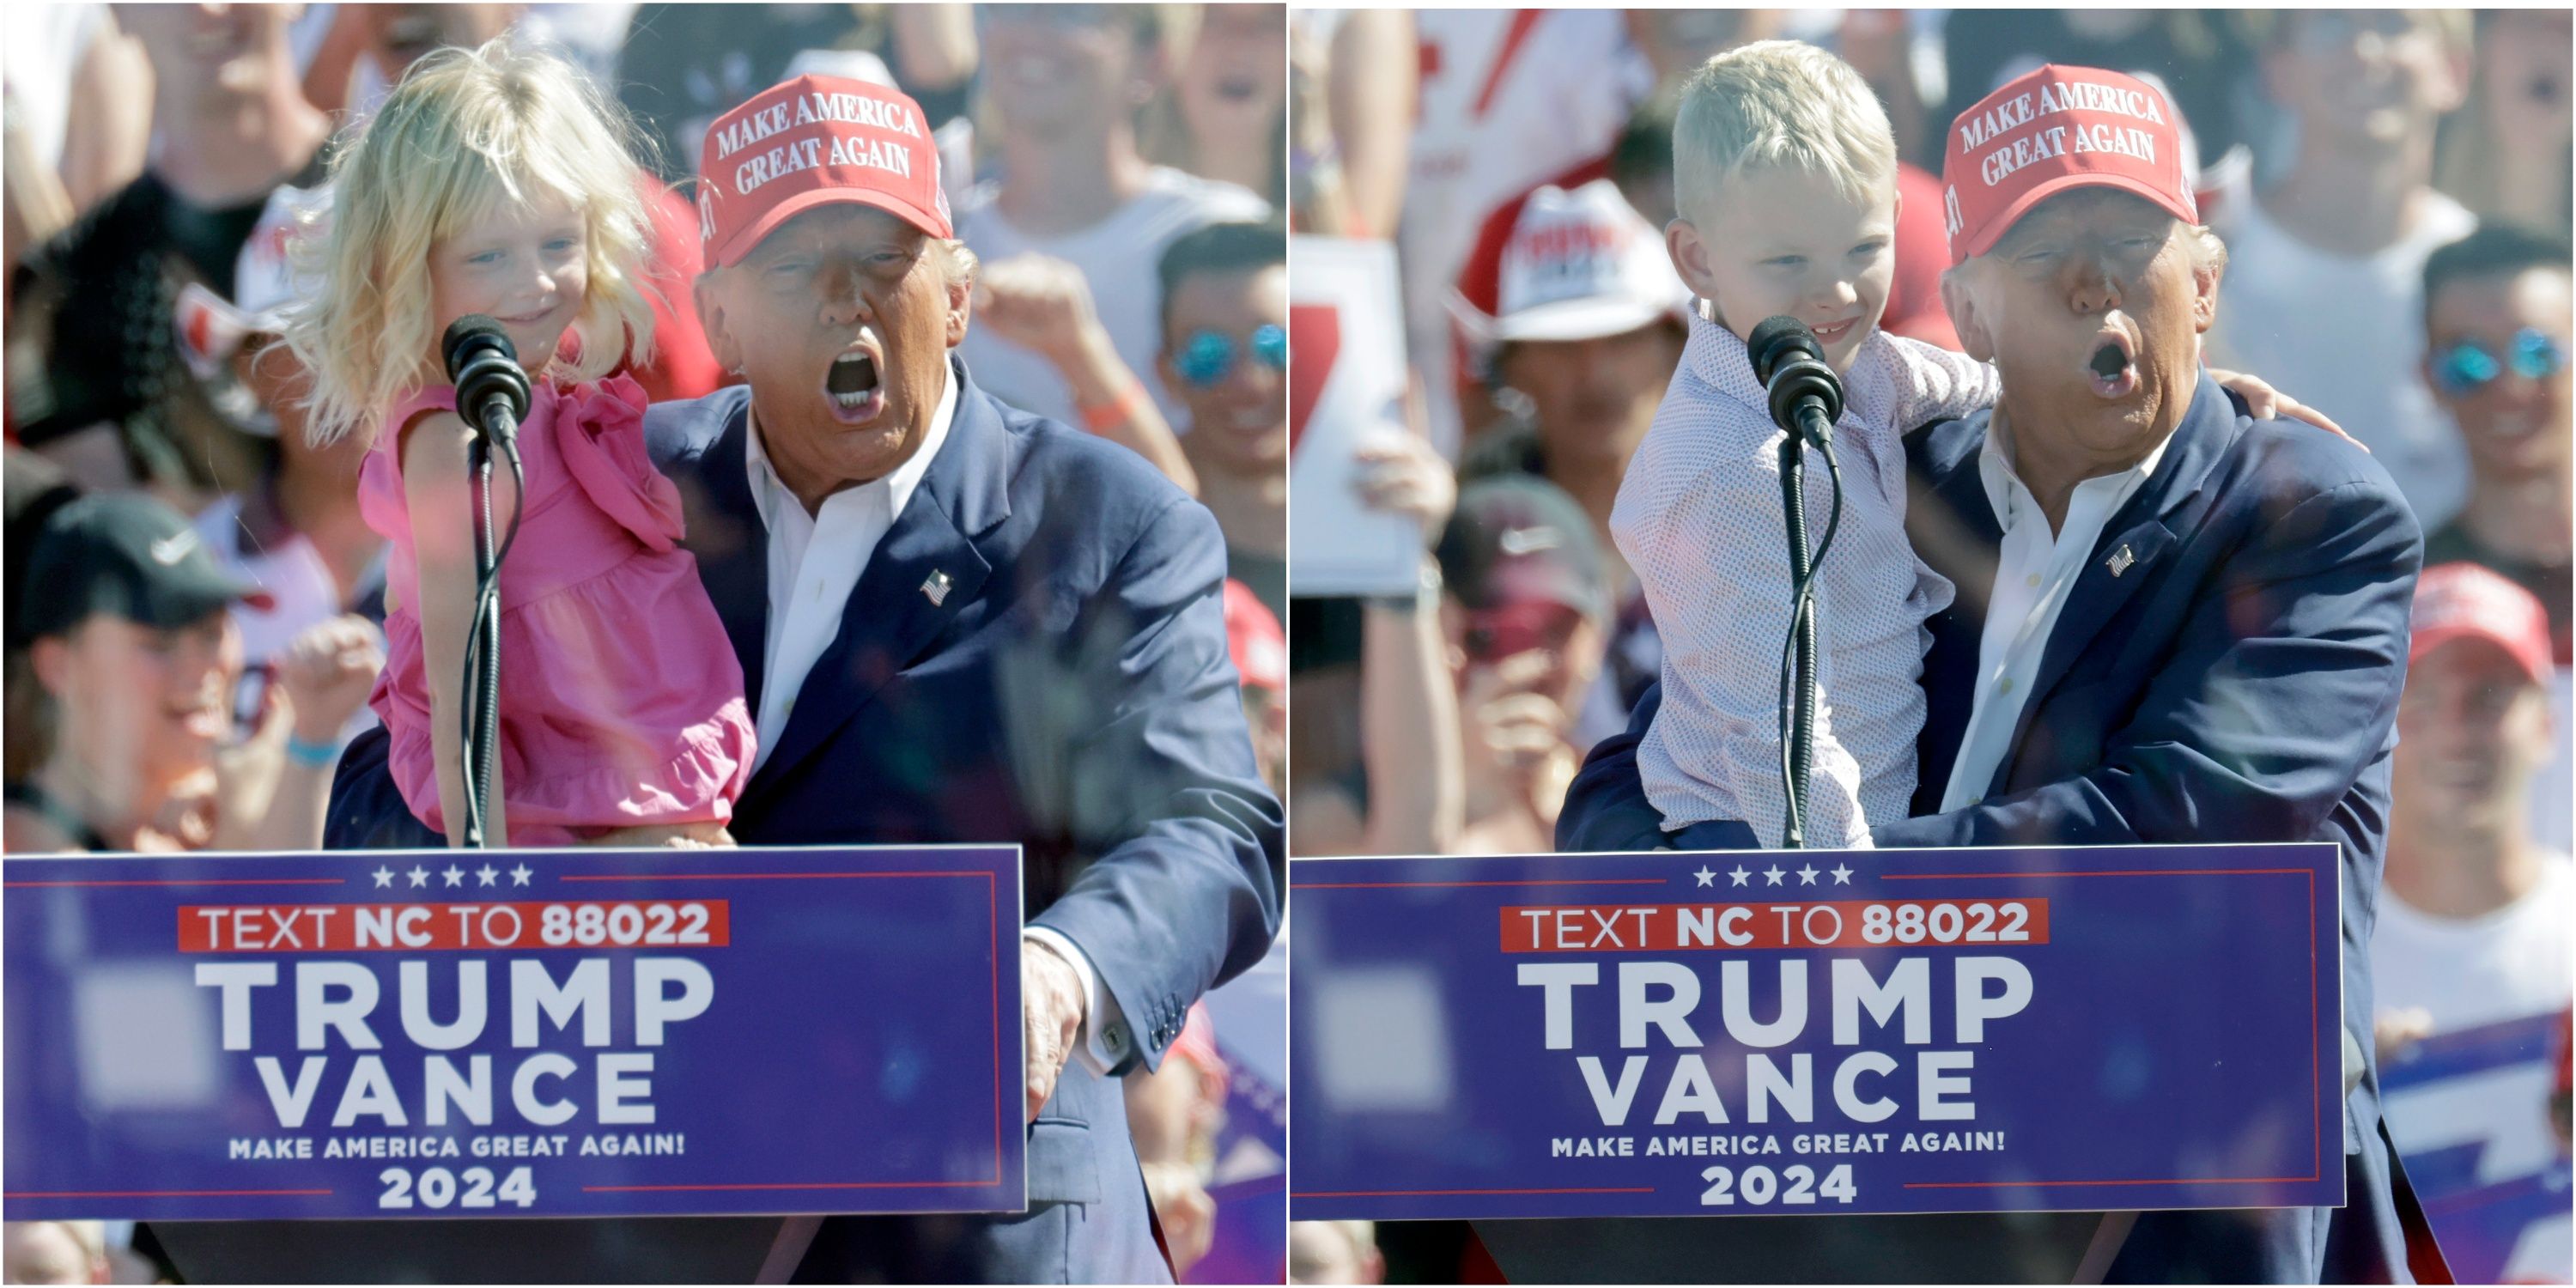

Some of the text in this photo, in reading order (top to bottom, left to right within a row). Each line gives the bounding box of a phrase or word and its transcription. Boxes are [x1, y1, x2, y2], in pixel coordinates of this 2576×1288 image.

[716, 92, 920, 161] MAKE AMERICA
[1960, 82, 2165, 155] MAKE AMERICA
[735, 136, 910, 195] GREAT AGAIN
[1981, 124, 2156, 186] GREAT AGAIN
[198, 903, 711, 950] TEXT NC TO 88022
[1521, 902, 2030, 949] TEXT NC TO 88022
[195, 957, 714, 1051] TRUMP
[1517, 956, 2034, 1049] TRUMP
[254, 1053, 656, 1127] VANCE
[1576, 1051, 1976, 1126] VANCE
[229, 1133, 684, 1159] MAKE AMERICA GREAT AGAIN!
[1552, 1132, 2005, 1157] MAKE AMERICA GREAT AGAIN!
[379, 1167, 537, 1209] 2024
[1701, 1164, 1857, 1206] 2024
